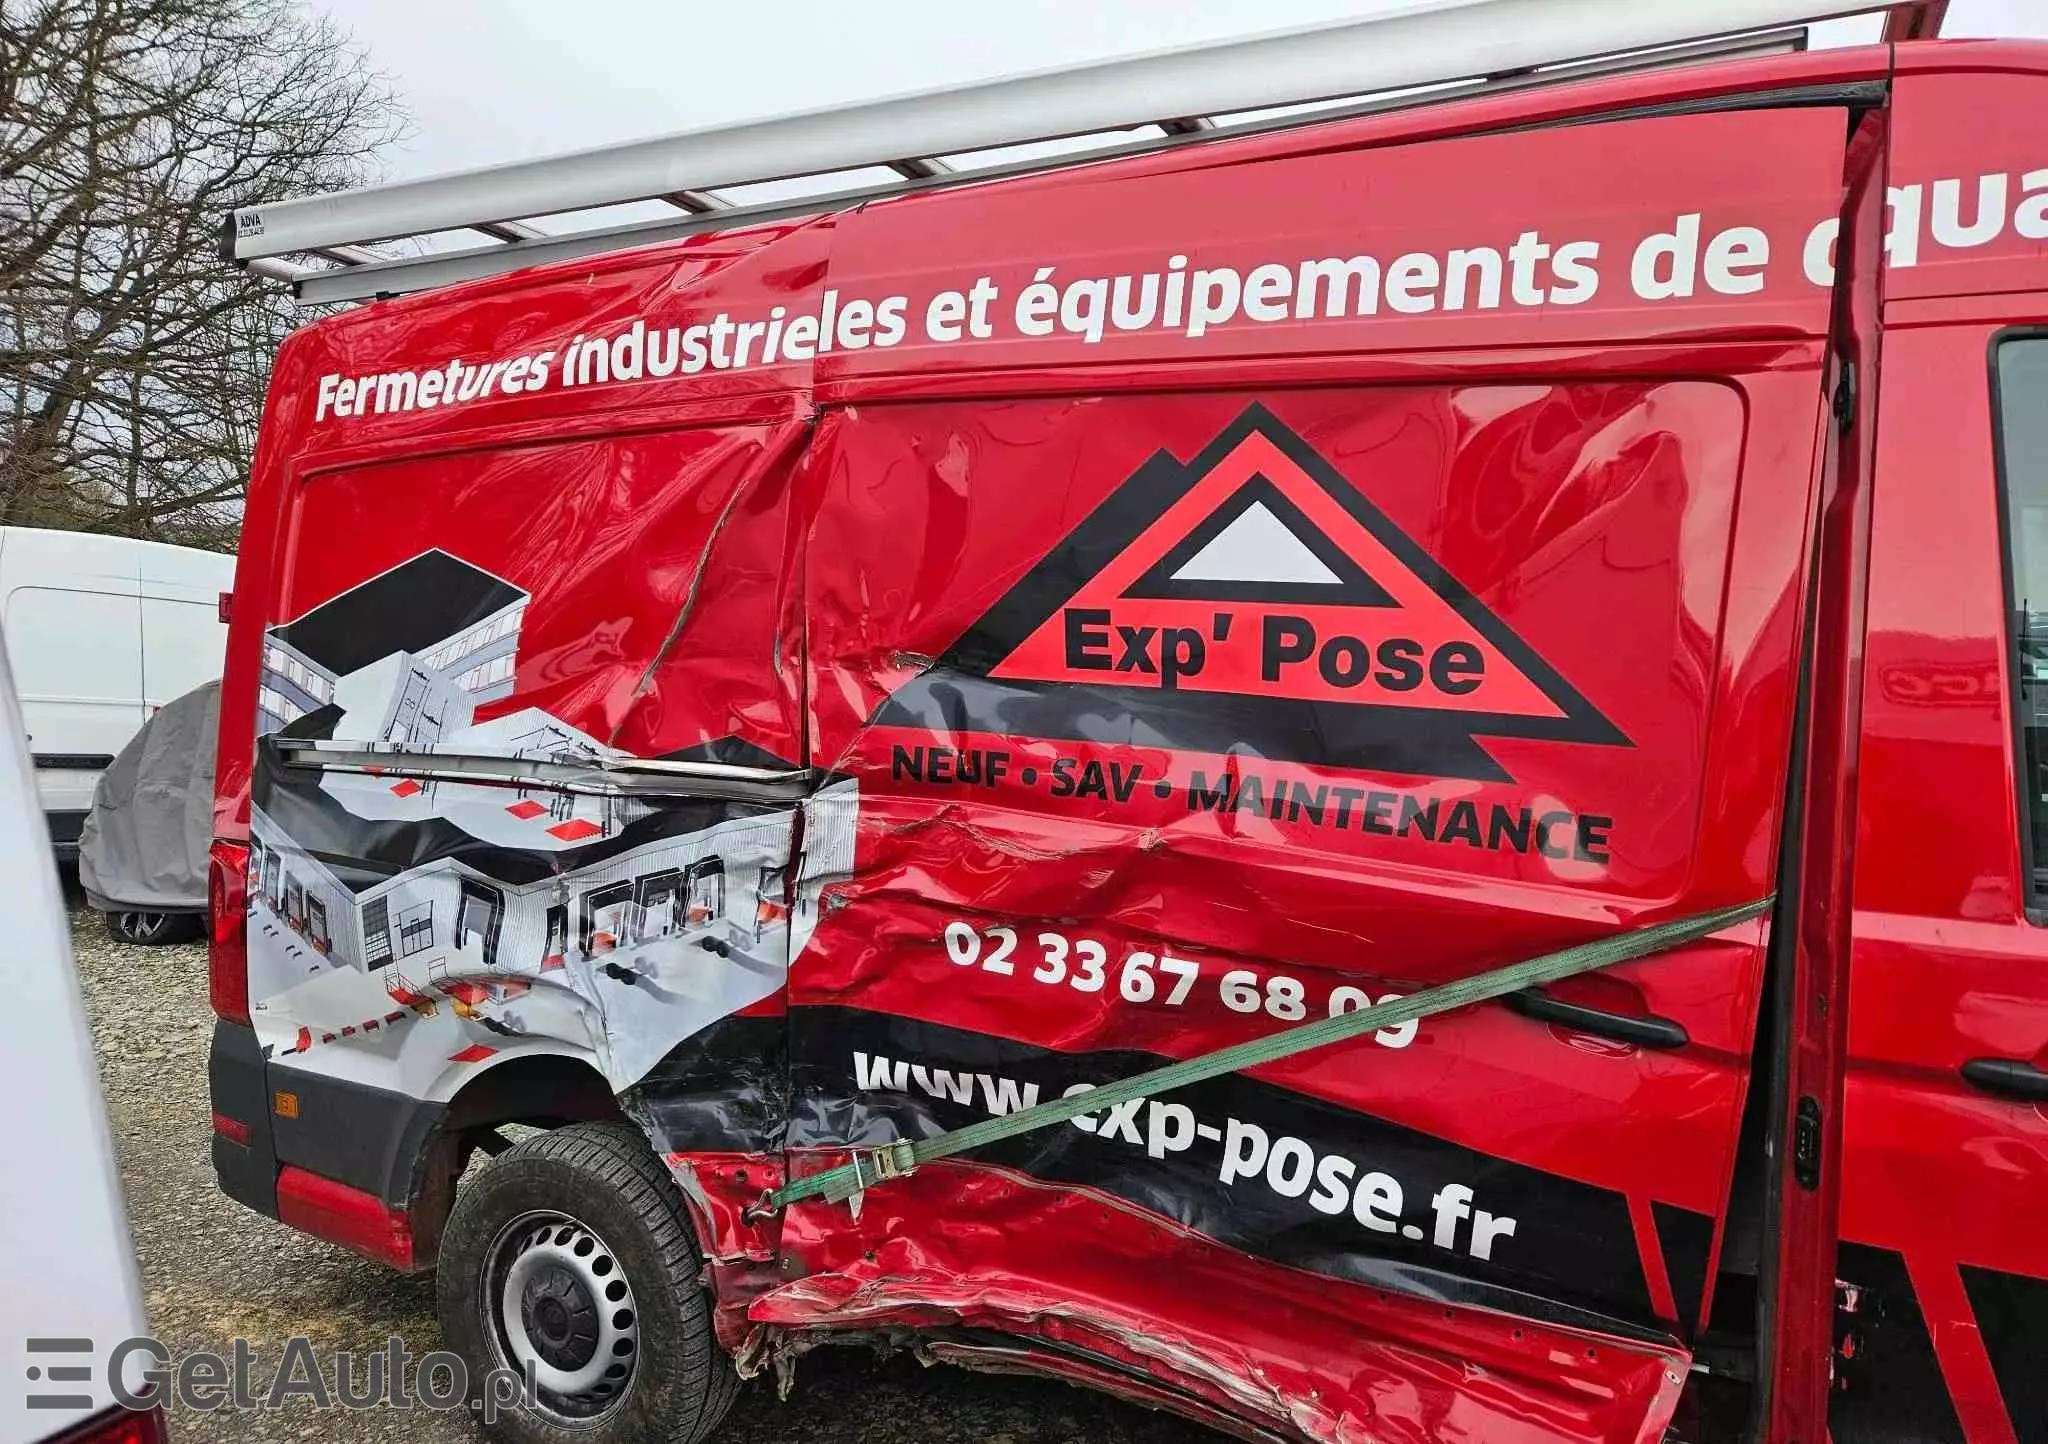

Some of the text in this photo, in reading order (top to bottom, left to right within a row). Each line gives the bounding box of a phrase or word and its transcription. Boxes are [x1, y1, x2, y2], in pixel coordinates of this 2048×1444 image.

[240, 214, 261, 228] ADVA
[315, 350, 558, 422] Fermetures
[562, 288, 908, 387] industrieles
[926, 276, 998, 342] et
[1014, 230, 1601, 343] équipements
[1630, 213, 1770, 300] de
[1261, 614, 1486, 696] Pose
[891, 745, 1614, 864] NEUF SAV MAINTENANCE
[944, 922, 1018, 976] 02
[1033, 932, 1107, 993] 33
[1120, 951, 1200, 1006] 67
[1219, 970, 1307, 1021] 68
[853, 1050, 1517, 1261] wwwexp-pose.fr
